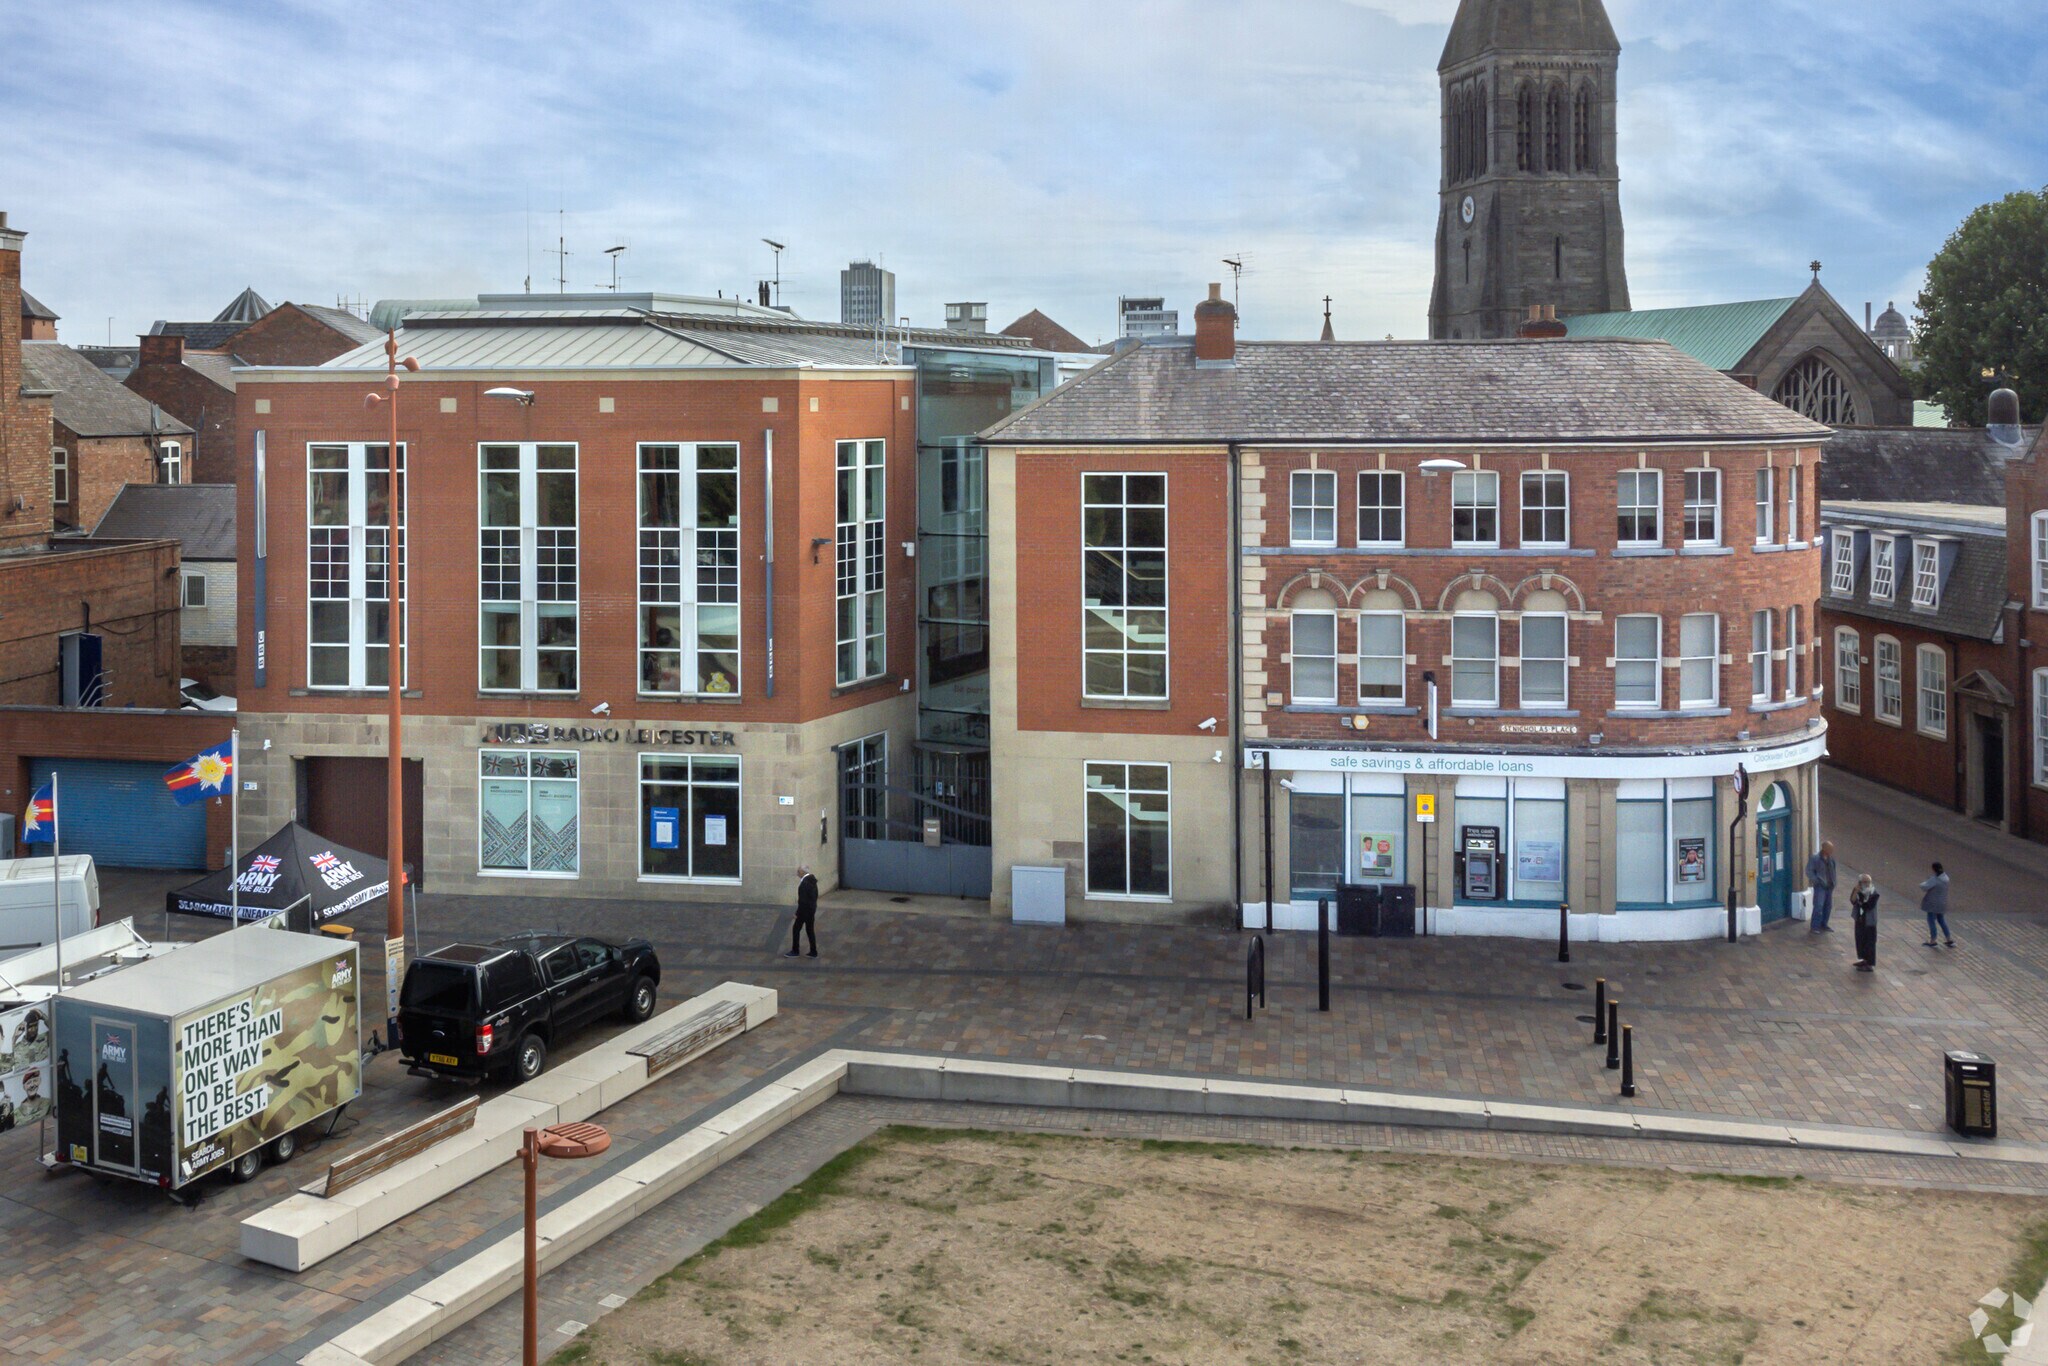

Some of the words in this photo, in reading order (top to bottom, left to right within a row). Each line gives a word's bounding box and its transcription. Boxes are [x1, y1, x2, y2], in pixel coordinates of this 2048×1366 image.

[554, 726, 619, 743] RADIO
[625, 728, 736, 746] LEICESTER
[1330, 755, 1358, 767] safe
[1361, 757, 1411, 771] savings
[1415, 758, 1424, 769] &
[1428, 758, 1494, 771] affordable
[1498, 760, 1534, 772] loans
[236, 871, 281, 886] ARMY
[320, 860, 357, 886] ARMY
[238, 884, 253, 892] THE
[253, 885, 274, 894] BEST
[178, 899, 213, 913] SEARCH
[322, 899, 350, 918] SEARCH
[349, 890, 368, 905] ARMY
[331, 966, 352, 985] ARMY
[184, 1001, 250, 1046] THERE'S
[102, 1044, 127, 1058] ARMY
[184, 1031, 233, 1071] MORE
[236, 1011, 281, 1047] THAN
[185, 1061, 219, 1094] ONE
[223, 1043, 260, 1077] WAY
[186, 1091, 207, 1118] TO
[213, 1078, 234, 1107] BE
[186, 1109, 219, 1142] THE
[224, 1088, 266, 1125] BEST.
[192, 1154, 210, 1169] ARMY
[209, 1147, 225, 1162] JOBS
